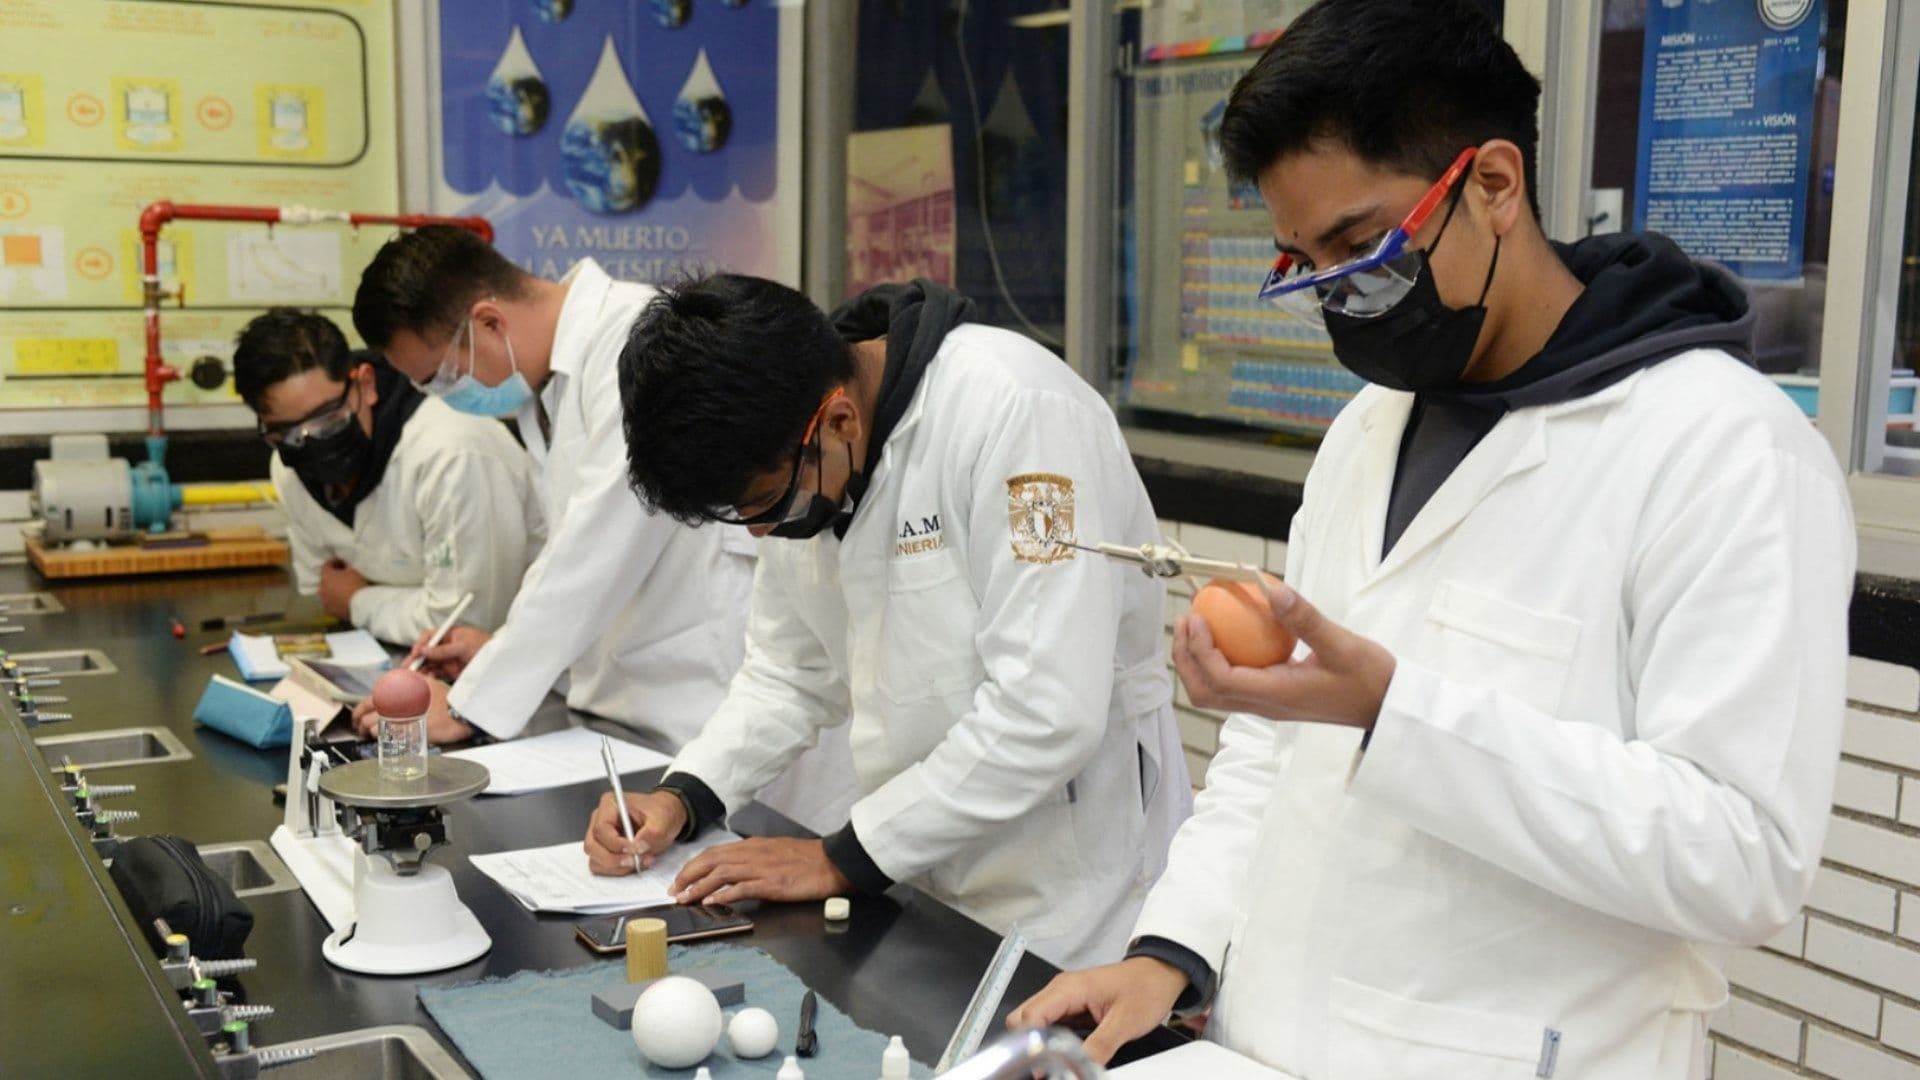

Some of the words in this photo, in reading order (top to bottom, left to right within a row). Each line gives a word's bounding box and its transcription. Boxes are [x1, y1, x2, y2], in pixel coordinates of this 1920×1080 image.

[1661, 32, 1695, 46] MISIÓN
[1763, 112, 1797, 126] VISIÓN
[532, 225, 569, 249] YA
